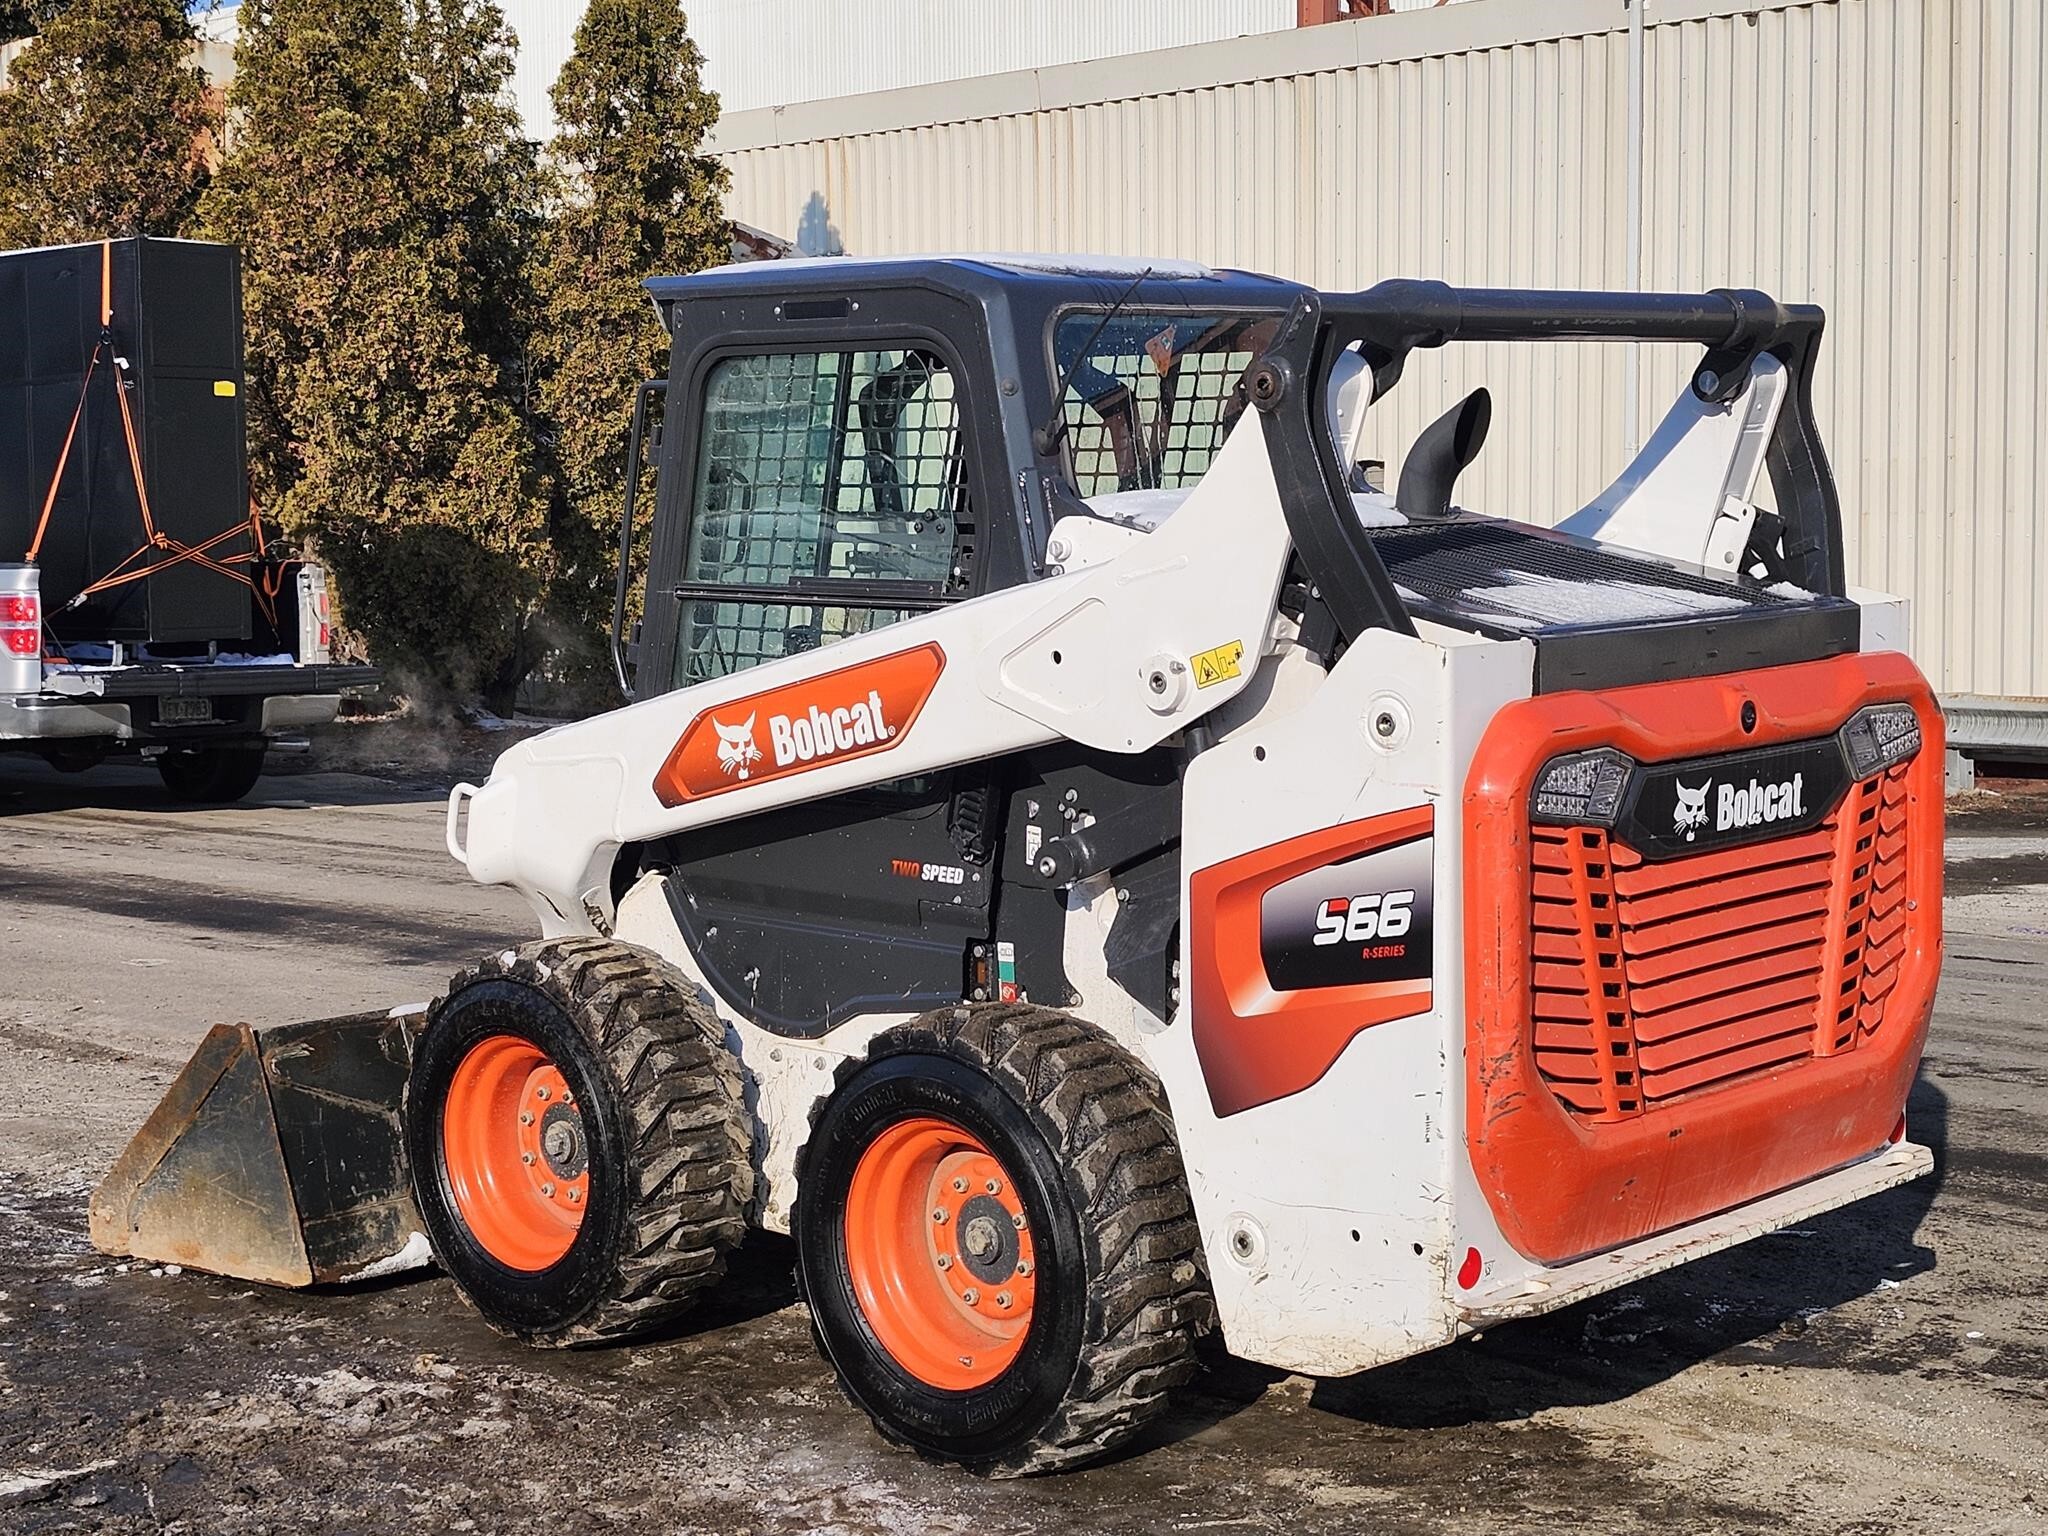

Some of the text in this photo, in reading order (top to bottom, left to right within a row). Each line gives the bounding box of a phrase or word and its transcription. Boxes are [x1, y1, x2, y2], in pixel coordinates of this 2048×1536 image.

[769, 690, 888, 766] Bobcat
[1717, 772, 1803, 832] Bobcat
[891, 860, 964, 885] TWO SPEED
[1313, 890, 1415, 946] S66
[1362, 944, 1406, 960] R-SERIES
